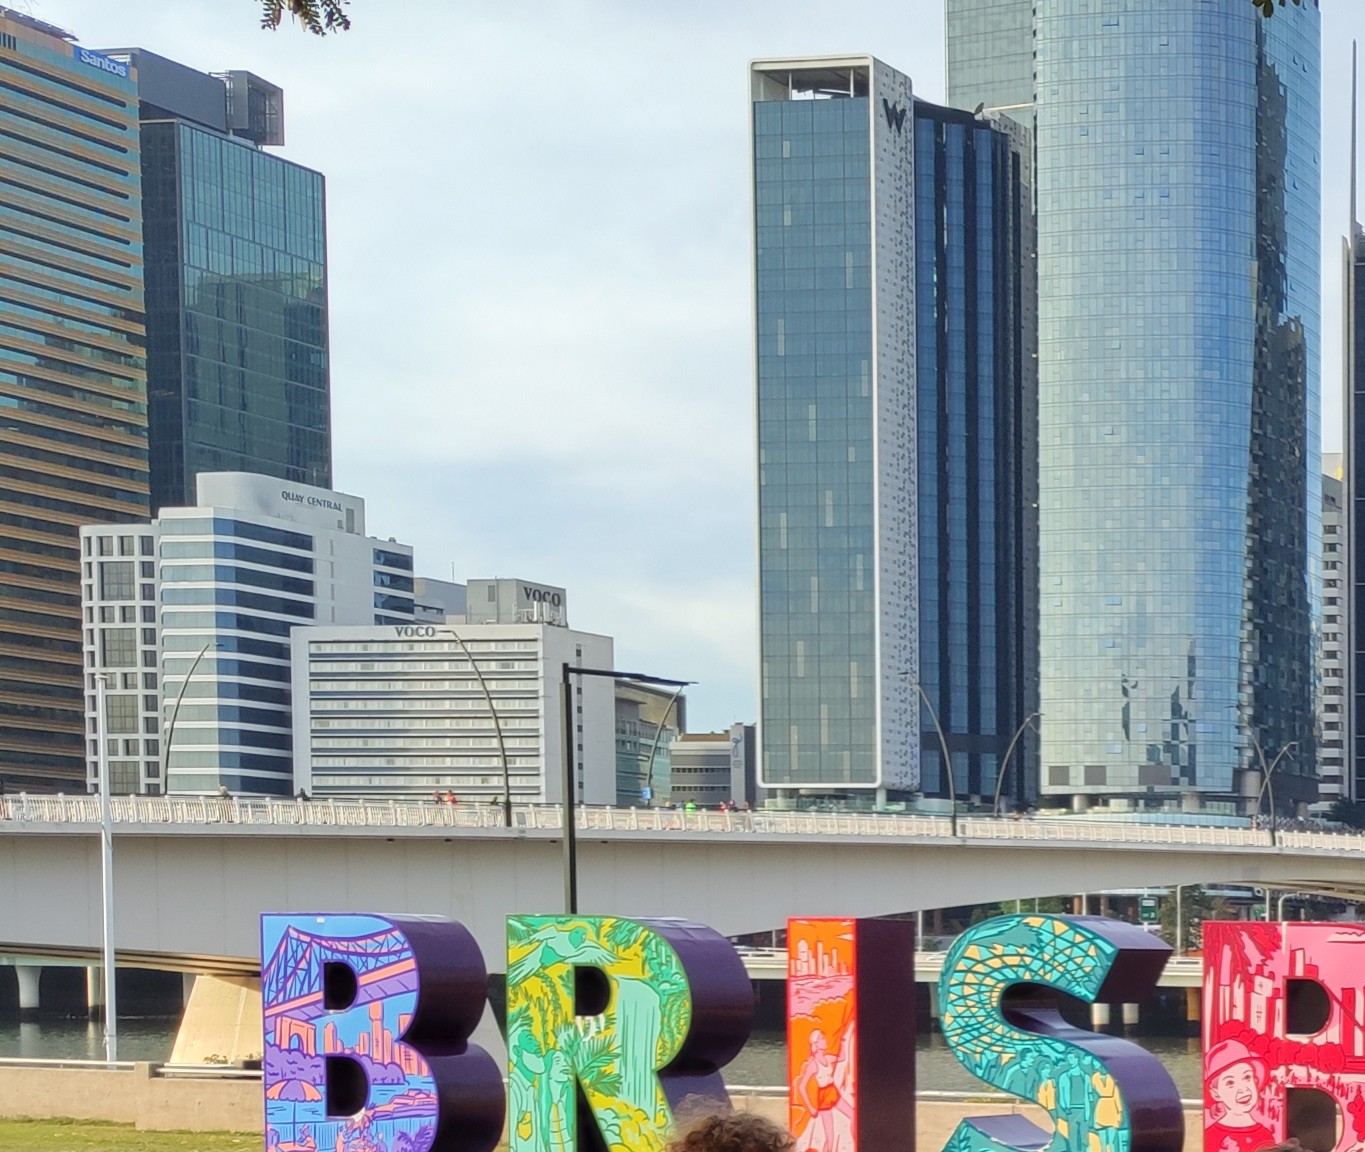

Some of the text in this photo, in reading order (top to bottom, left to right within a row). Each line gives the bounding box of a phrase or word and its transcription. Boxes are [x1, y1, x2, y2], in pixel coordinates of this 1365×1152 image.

[882, 97, 907, 137] W
[281, 490, 343, 512] QUAY CENTRAL
